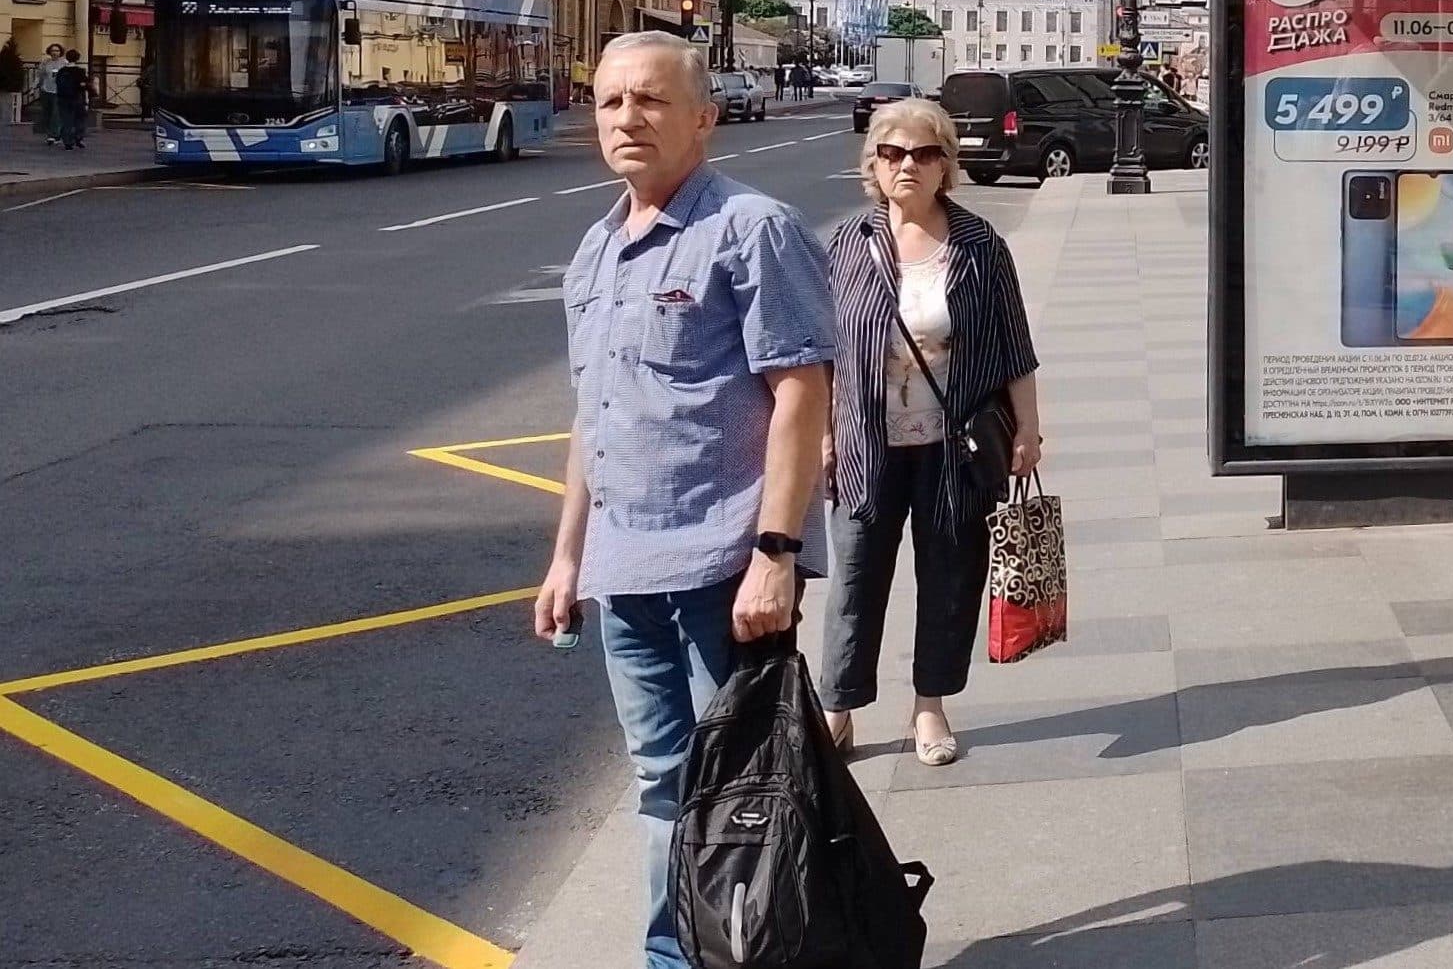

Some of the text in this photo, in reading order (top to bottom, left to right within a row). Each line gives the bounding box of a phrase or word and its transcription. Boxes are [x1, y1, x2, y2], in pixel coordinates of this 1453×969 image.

[1268, 9, 1348, 32] РАСПРО
[1267, 26, 1347, 52] ДАЖА
[1428, 113, 1451, 122] 3/64
